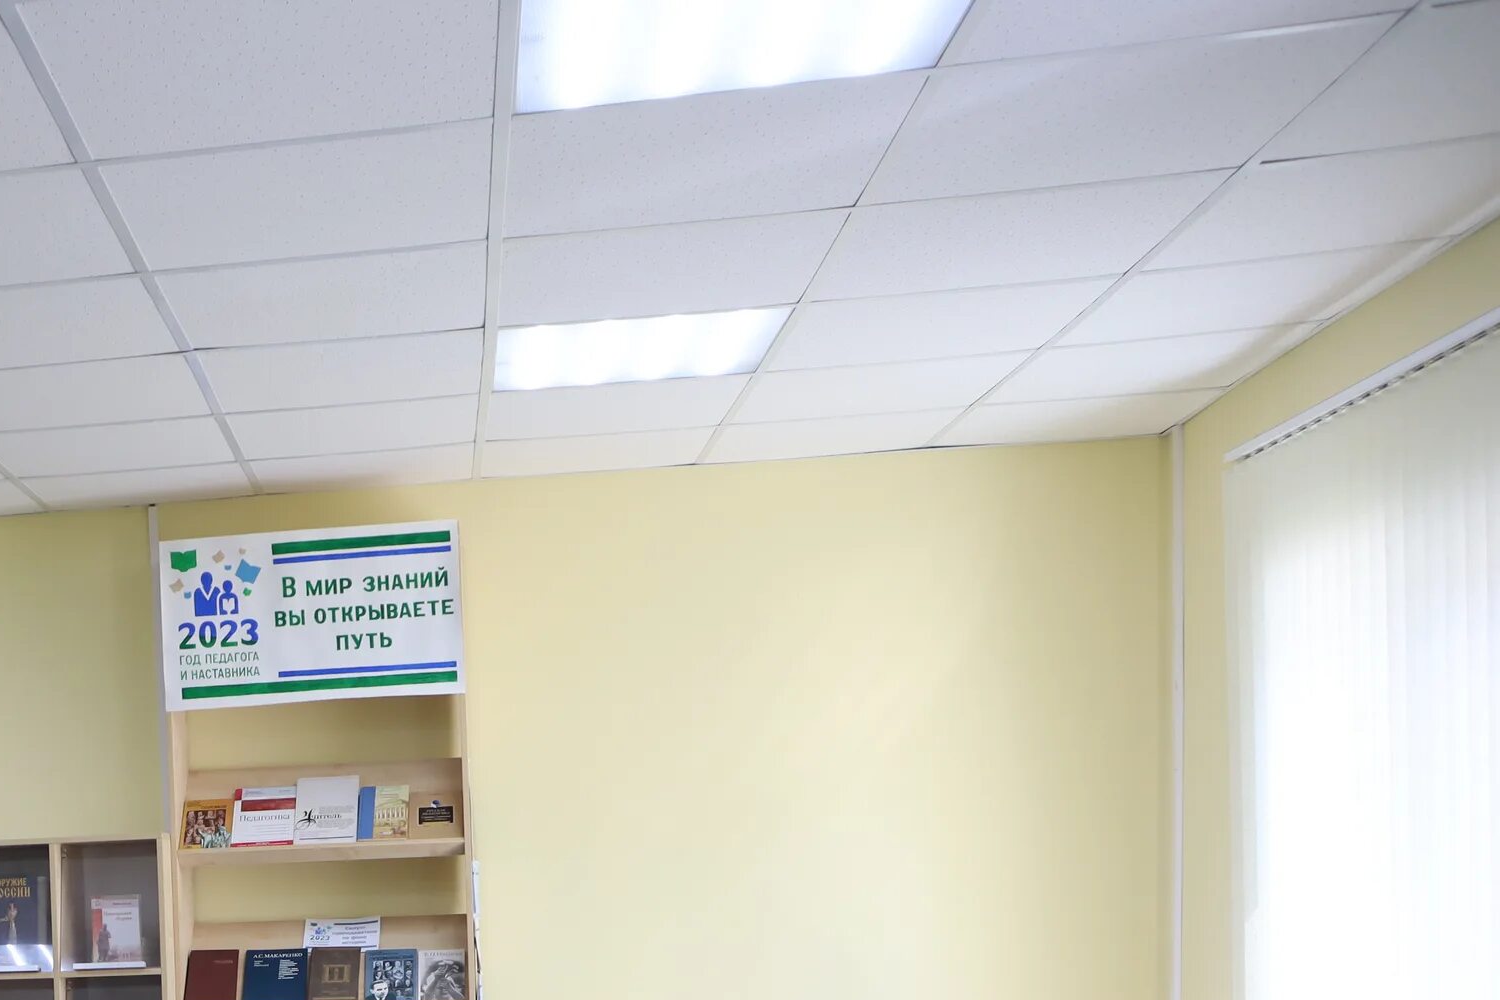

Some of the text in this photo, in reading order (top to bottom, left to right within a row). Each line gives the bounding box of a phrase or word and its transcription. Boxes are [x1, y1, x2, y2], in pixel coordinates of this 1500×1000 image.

[282, 576, 297, 598] В
[178, 619, 259, 650] 2023
[336, 632, 393, 651] ПУТЬ
[179, 651, 260, 666] ГОД ПЕДАГОГА
[180, 666, 261, 681] И НАСТАВНИКА
